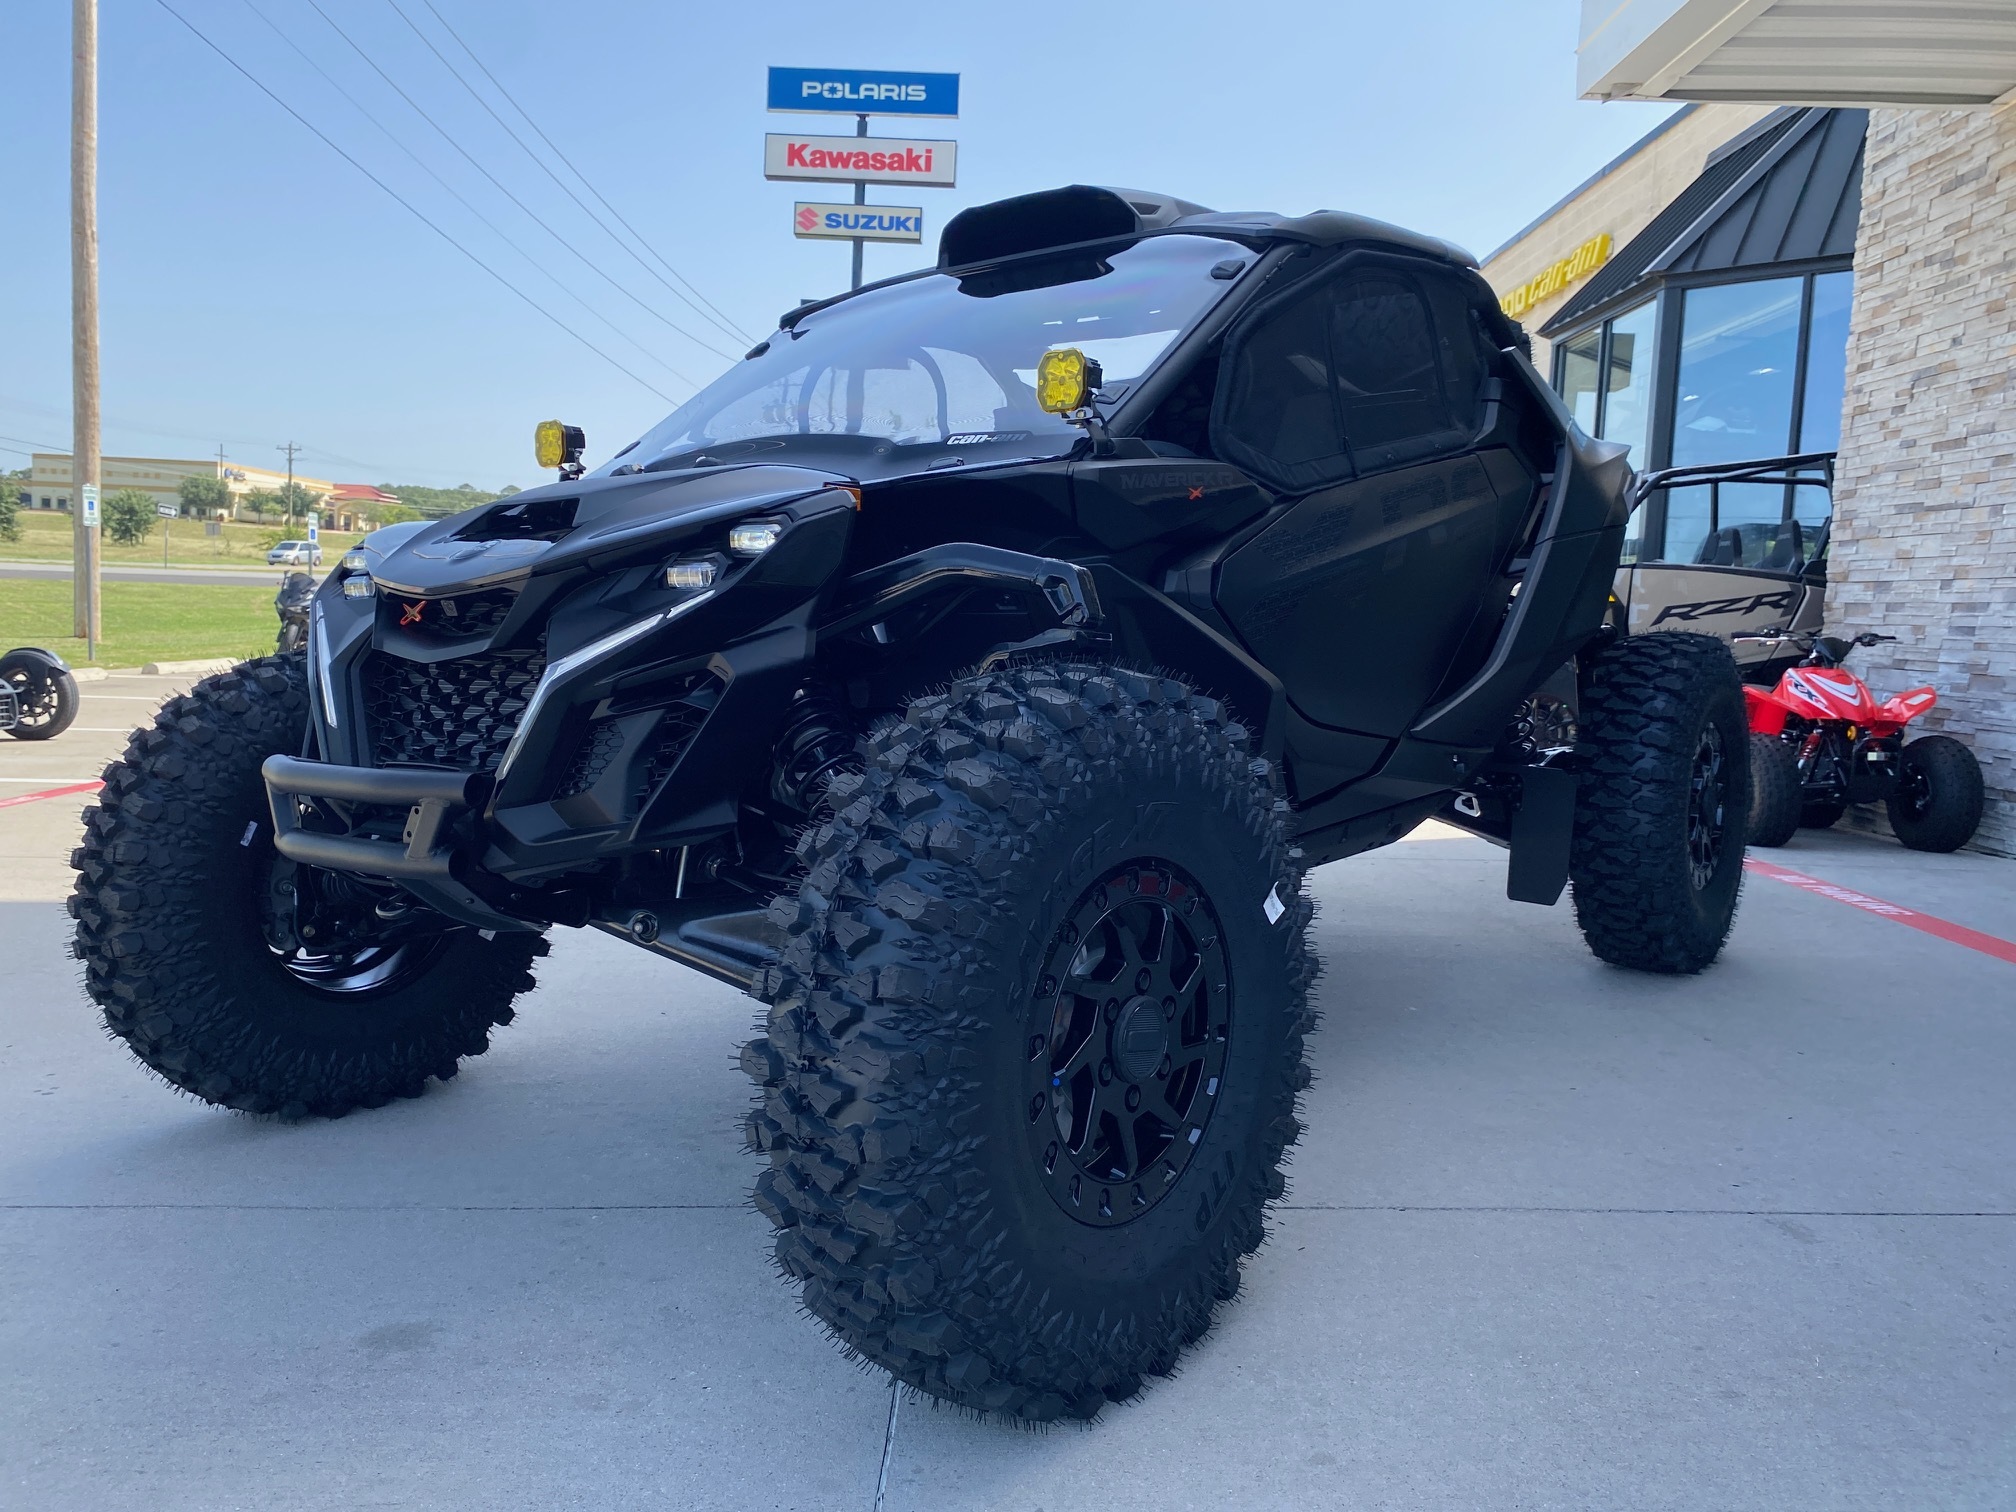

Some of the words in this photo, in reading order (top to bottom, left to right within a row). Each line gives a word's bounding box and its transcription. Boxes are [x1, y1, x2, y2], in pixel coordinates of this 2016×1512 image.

[802, 81, 927, 101] POLARIS
[787, 143, 933, 173] Kawasaki
[824, 212, 920, 233] SUZUKI
[947, 432, 1028, 445] can-am
[1650, 590, 1796, 627] RZR
